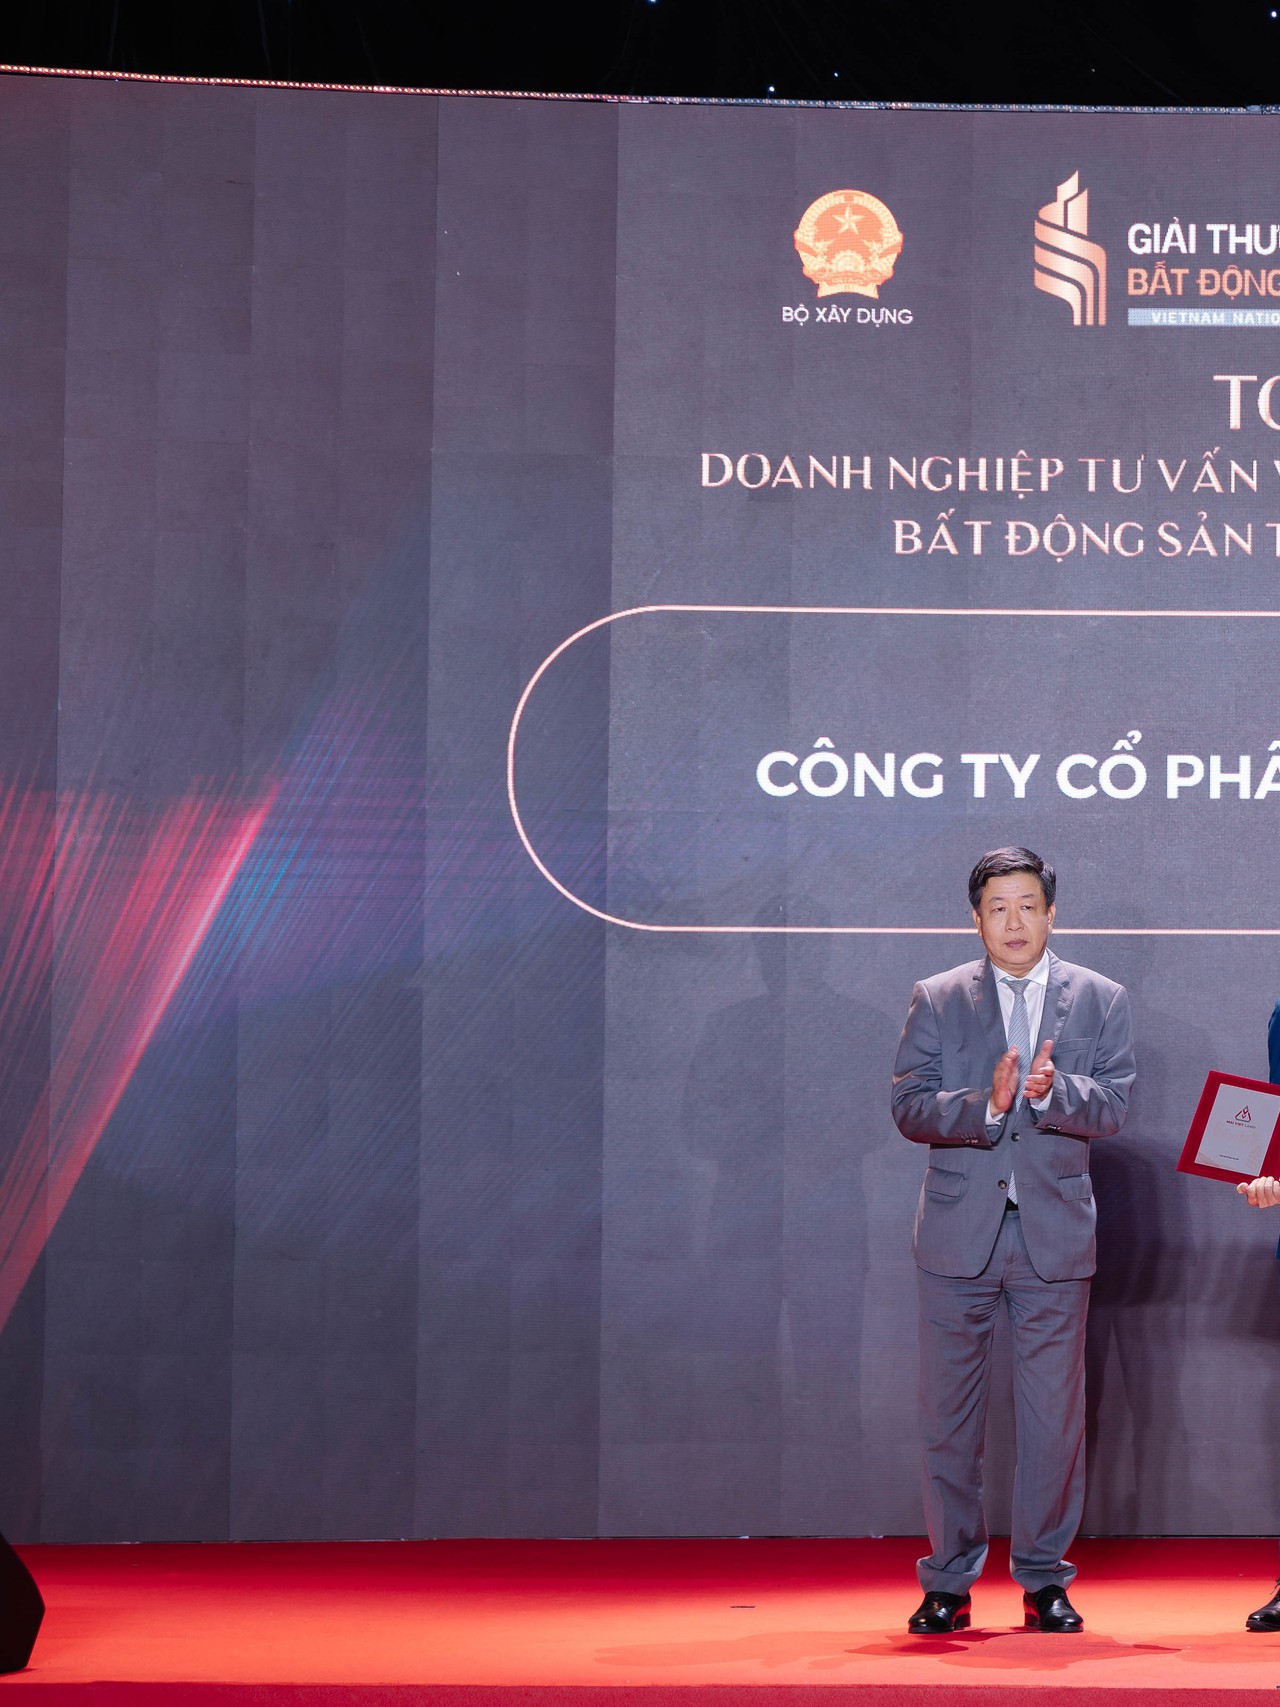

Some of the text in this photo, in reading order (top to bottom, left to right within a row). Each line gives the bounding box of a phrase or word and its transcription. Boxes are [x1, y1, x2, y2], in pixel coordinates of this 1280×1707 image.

[1127, 216, 1197, 255] GIẢI
[1127, 259, 1190, 297] BẤT
[782, 303, 914, 328] BỘ XÂY DỰNG
[1151, 312, 1225, 325] VIETNAM
[700, 452, 873, 490] DOANH
[888, 449, 1064, 499] NGHIỆP
[1078, 454, 1146, 493] TƯ
[1157, 446, 1258, 494] VẤN
[893, 508, 992, 555] BẤT
[1004, 513, 1145, 563] ĐỘNG
[1157, 511, 1252, 557] SẢN
[755, 736, 944, 799] CÔNG
[960, 752, 1041, 799] TY
[1055, 729, 1148, 800] CỔ
